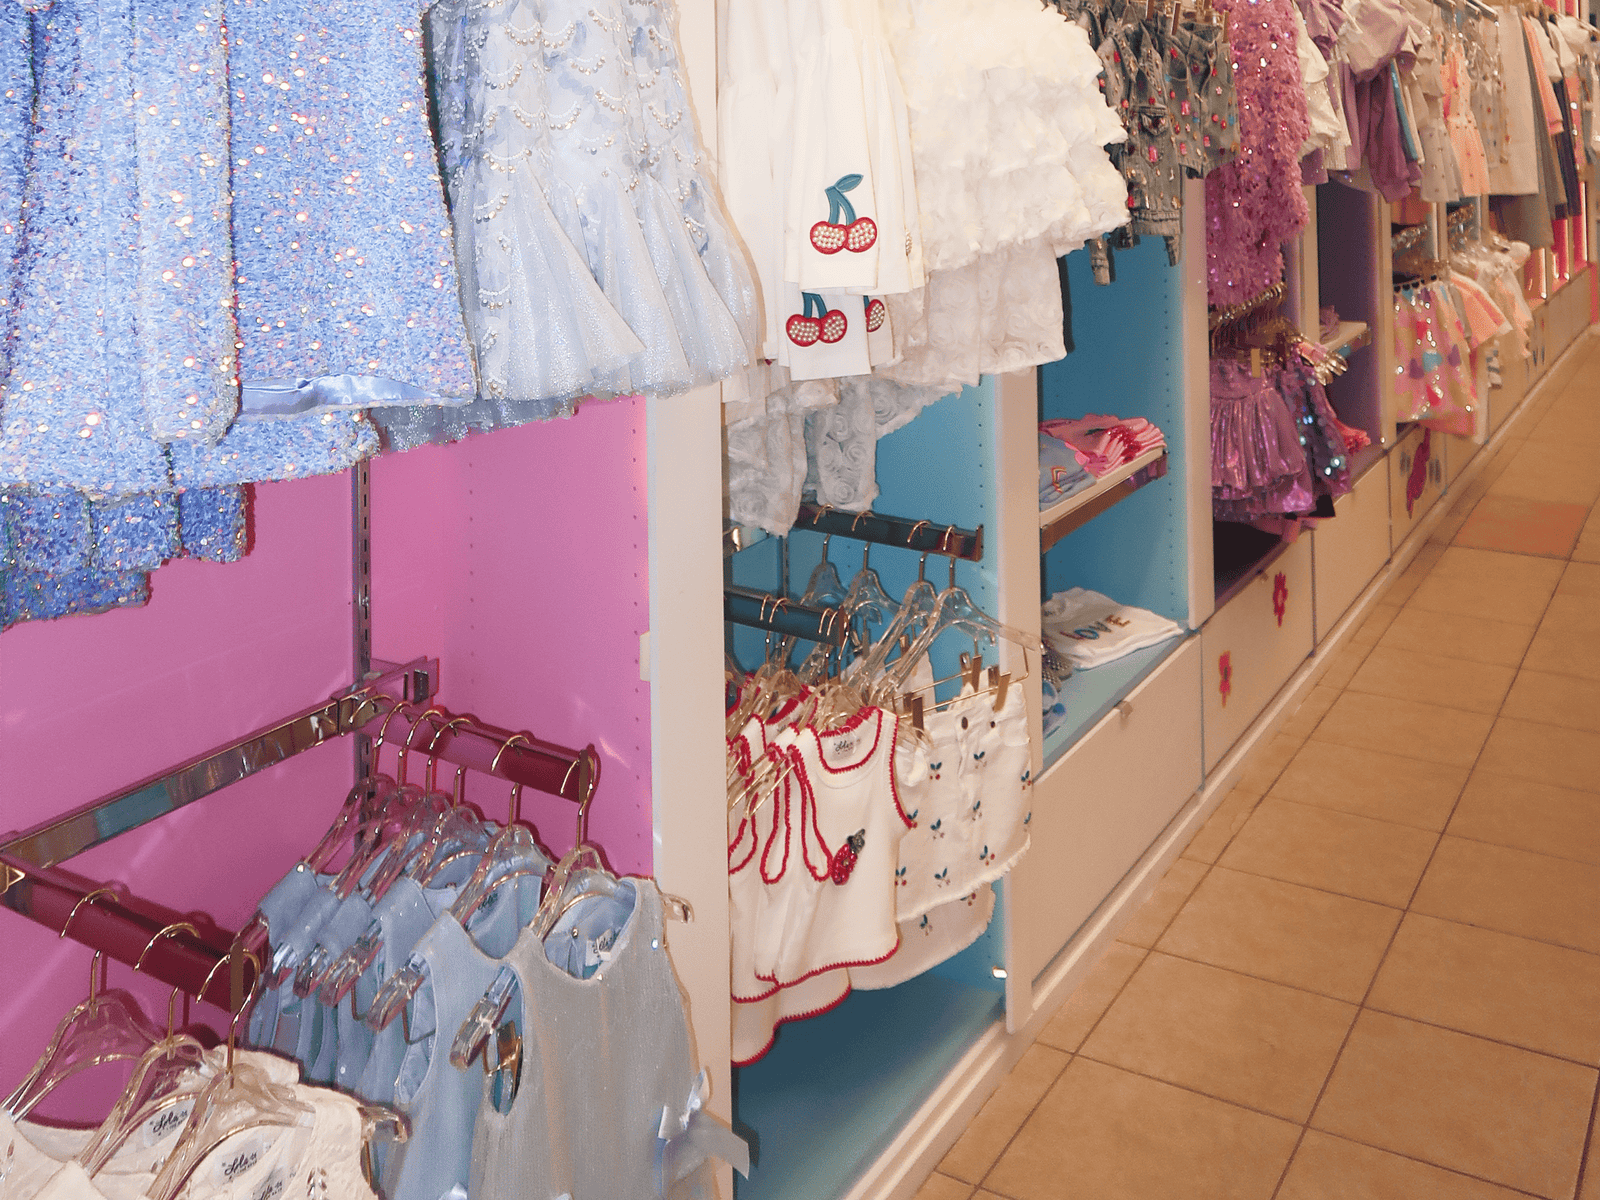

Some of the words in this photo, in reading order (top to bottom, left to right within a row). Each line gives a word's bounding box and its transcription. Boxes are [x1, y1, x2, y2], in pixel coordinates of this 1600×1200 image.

[1059, 614, 1131, 641] LOVE
[152, 1111, 179, 1135] Lola
[224, 1152, 249, 1176] Lola
